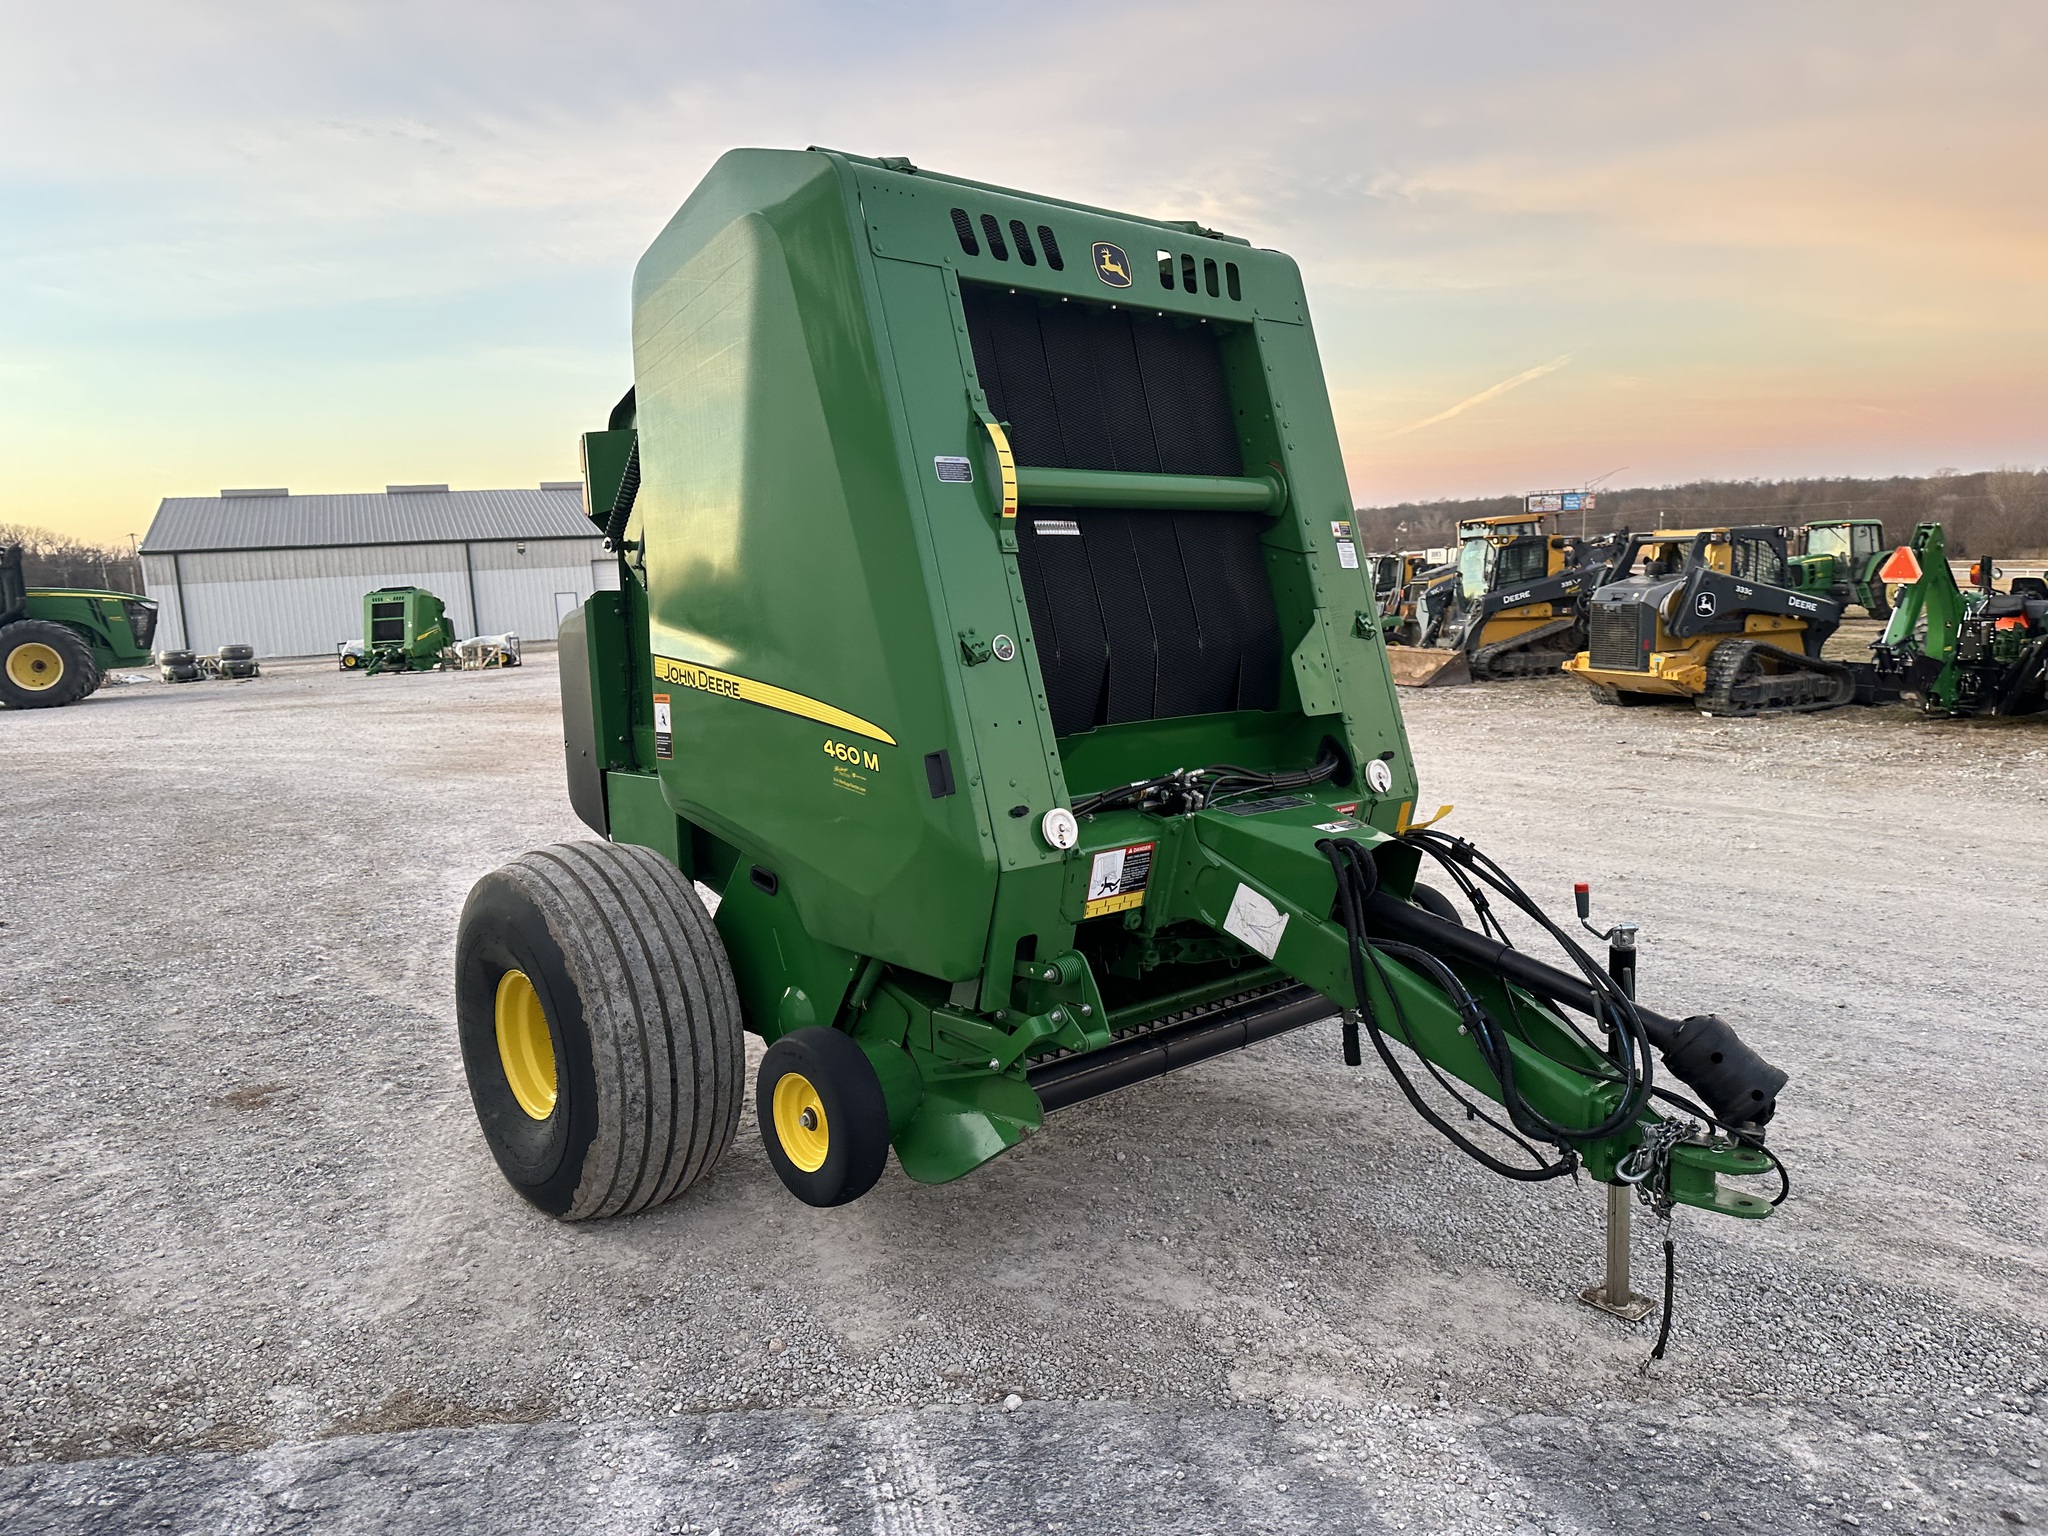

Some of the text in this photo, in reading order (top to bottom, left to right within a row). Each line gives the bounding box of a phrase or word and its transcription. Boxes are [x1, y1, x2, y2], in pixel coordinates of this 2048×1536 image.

[1503, 590, 1531, 604] DEERE
[1788, 596, 1818, 612] DEERE
[664, 663, 741, 697] JOHN DEERE
[823, 739, 880, 773] 460 M
[1133, 845, 1152, 853] DANGER
